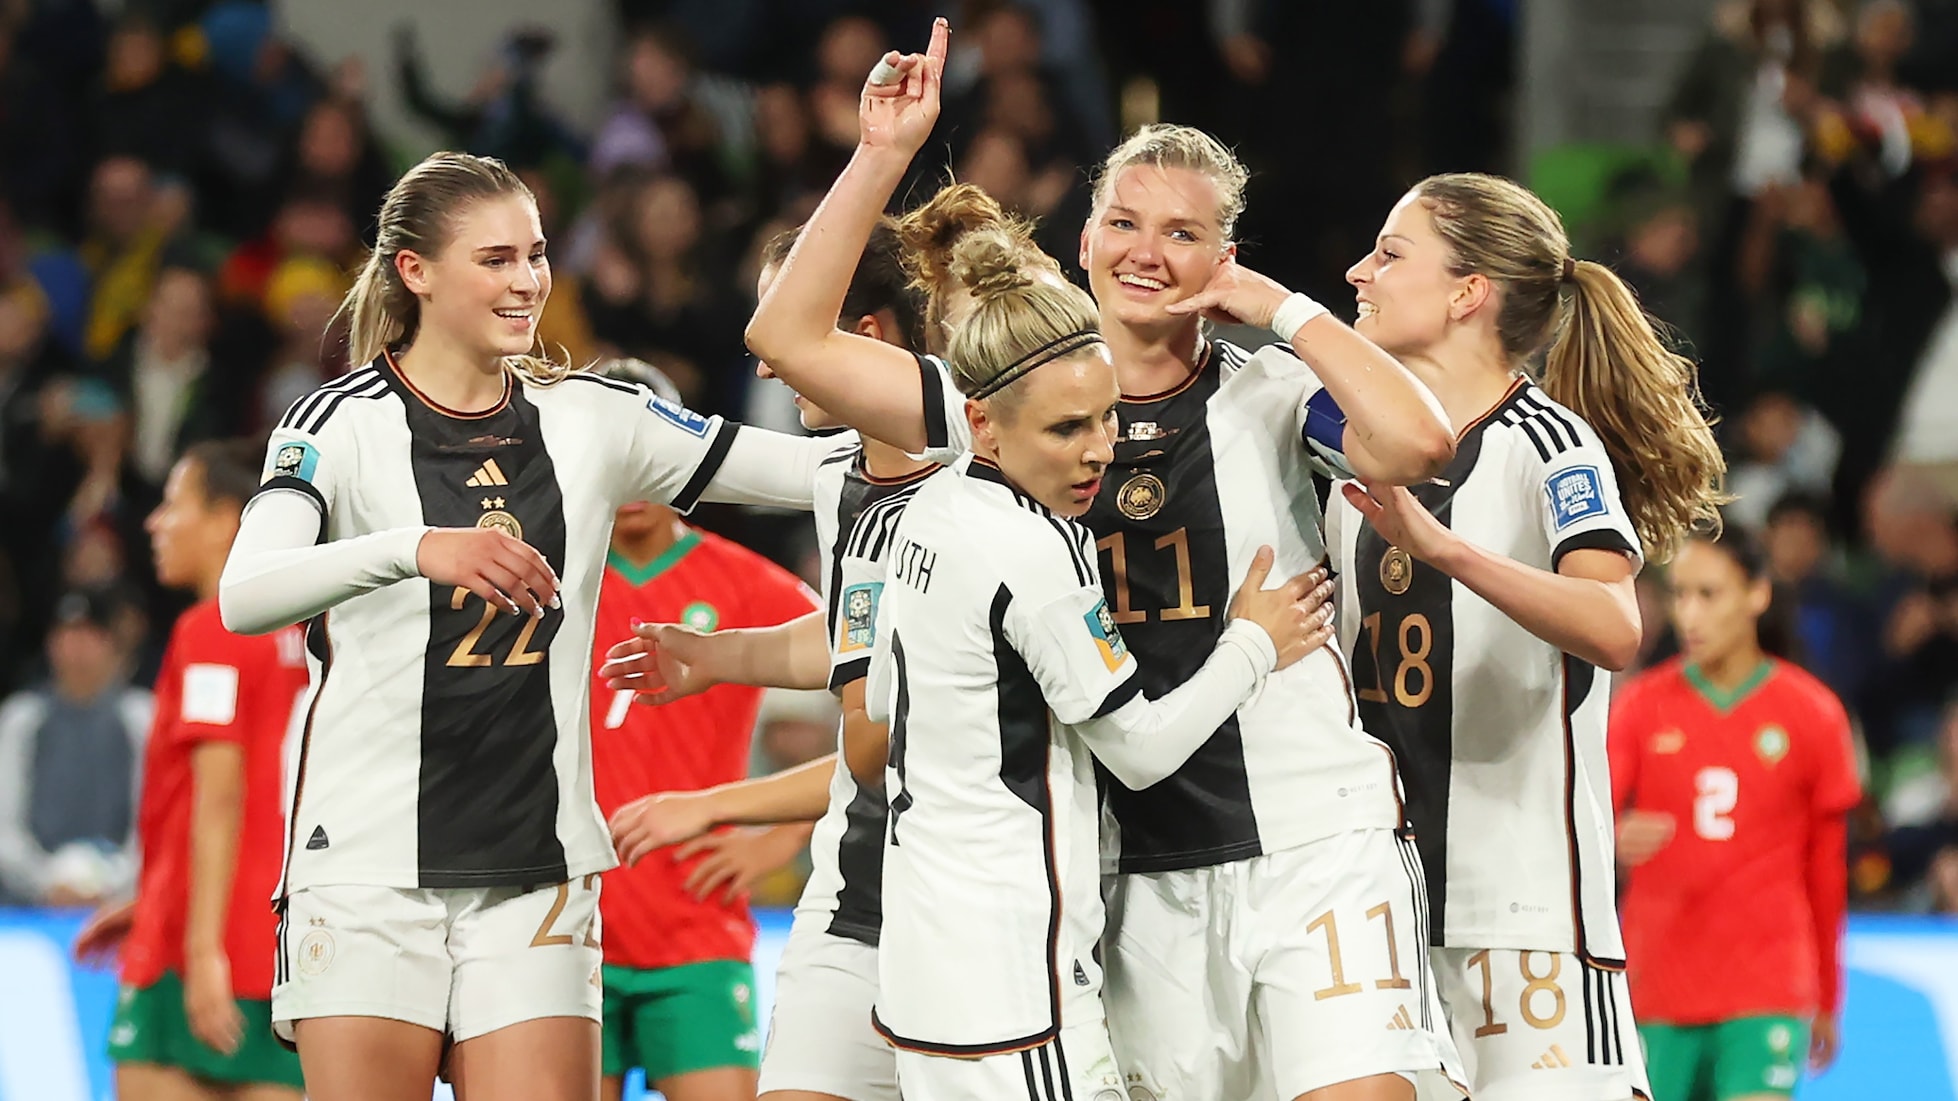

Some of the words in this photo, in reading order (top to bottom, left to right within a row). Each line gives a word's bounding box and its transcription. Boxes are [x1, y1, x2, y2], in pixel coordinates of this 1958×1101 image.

[1558, 481, 1592, 500] UNITES
[1096, 526, 1210, 624] 11
[1358, 610, 1434, 708] 18
[1693, 765, 1739, 841] 2
[1306, 900, 1412, 1001] 11
[1467, 948, 1566, 1036] 18
